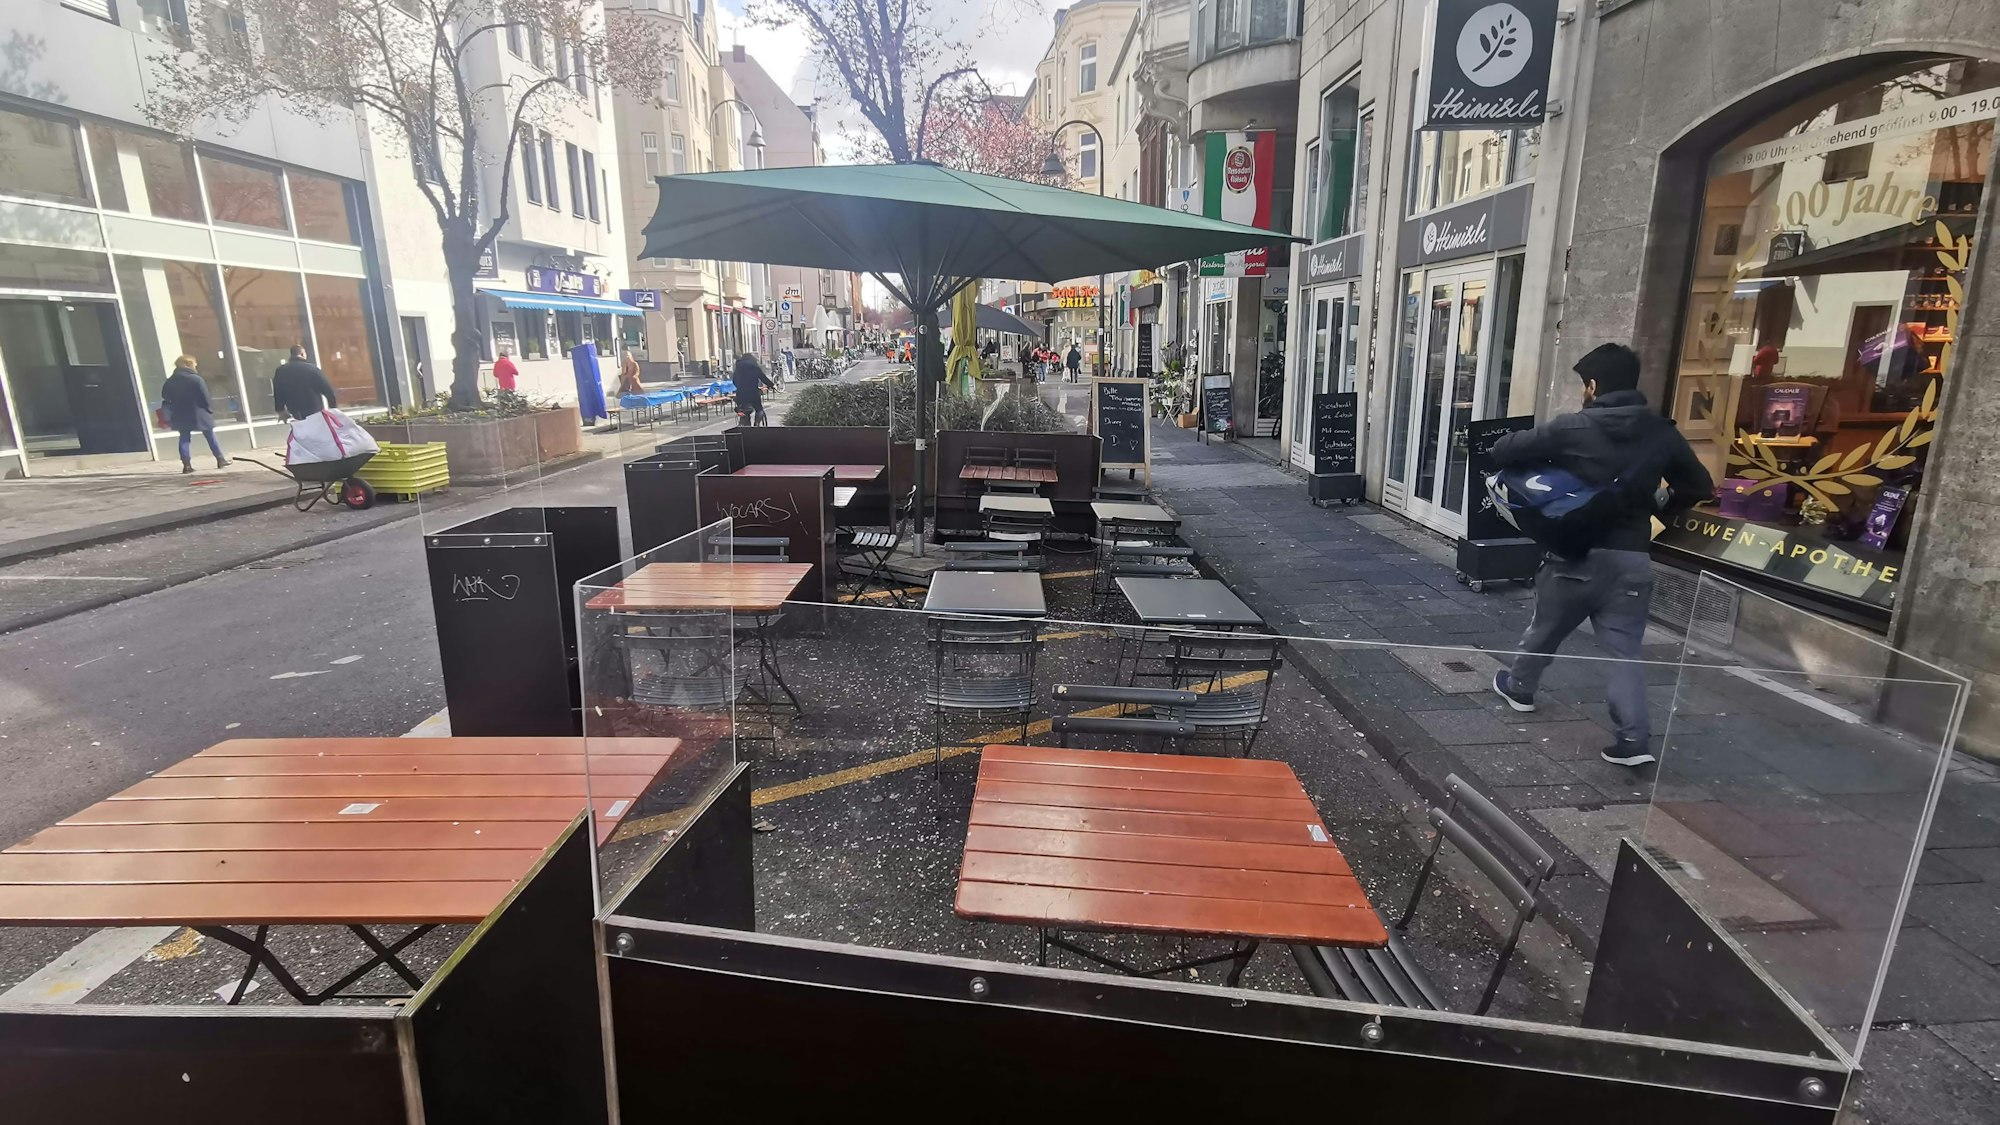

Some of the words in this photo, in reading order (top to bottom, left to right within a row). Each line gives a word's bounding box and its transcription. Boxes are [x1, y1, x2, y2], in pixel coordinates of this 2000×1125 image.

[1431, 87, 1541, 119] Heimisch
[1770, 145, 1788, 159] Uhr
[1929, 105, 1958, 123] 9.00
[1832, 171, 1937, 226] Jahre
[1435, 213, 1487, 252] Heimisch
[1316, 252, 1343, 275] Heimisch
[785, 286, 799, 295] dm
[1059, 297, 1095, 308] GRILL
